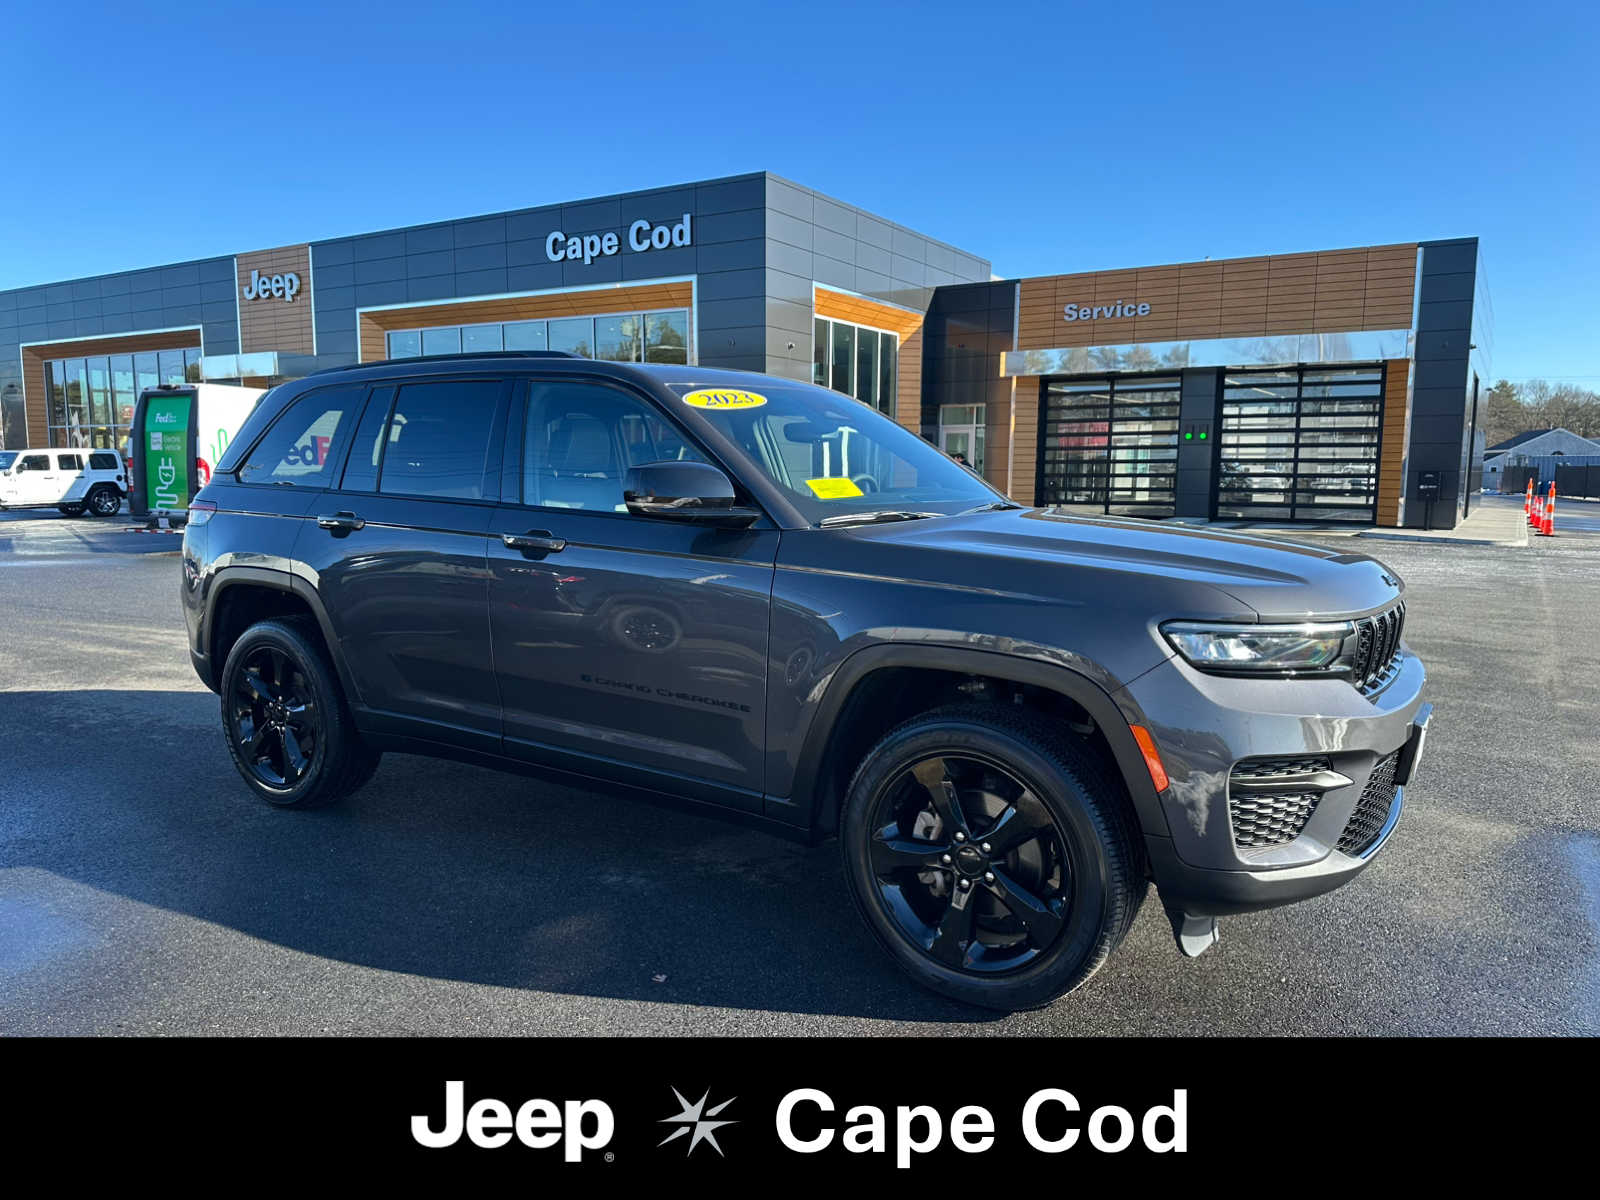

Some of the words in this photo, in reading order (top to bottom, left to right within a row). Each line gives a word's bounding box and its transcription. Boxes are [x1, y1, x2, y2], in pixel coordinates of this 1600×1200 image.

[546, 231, 619, 264] Cape
[629, 213, 691, 252] Cod
[243, 269, 301, 302] Jeep
[1063, 300, 1151, 321] Service
[698, 392, 755, 406] 2023
